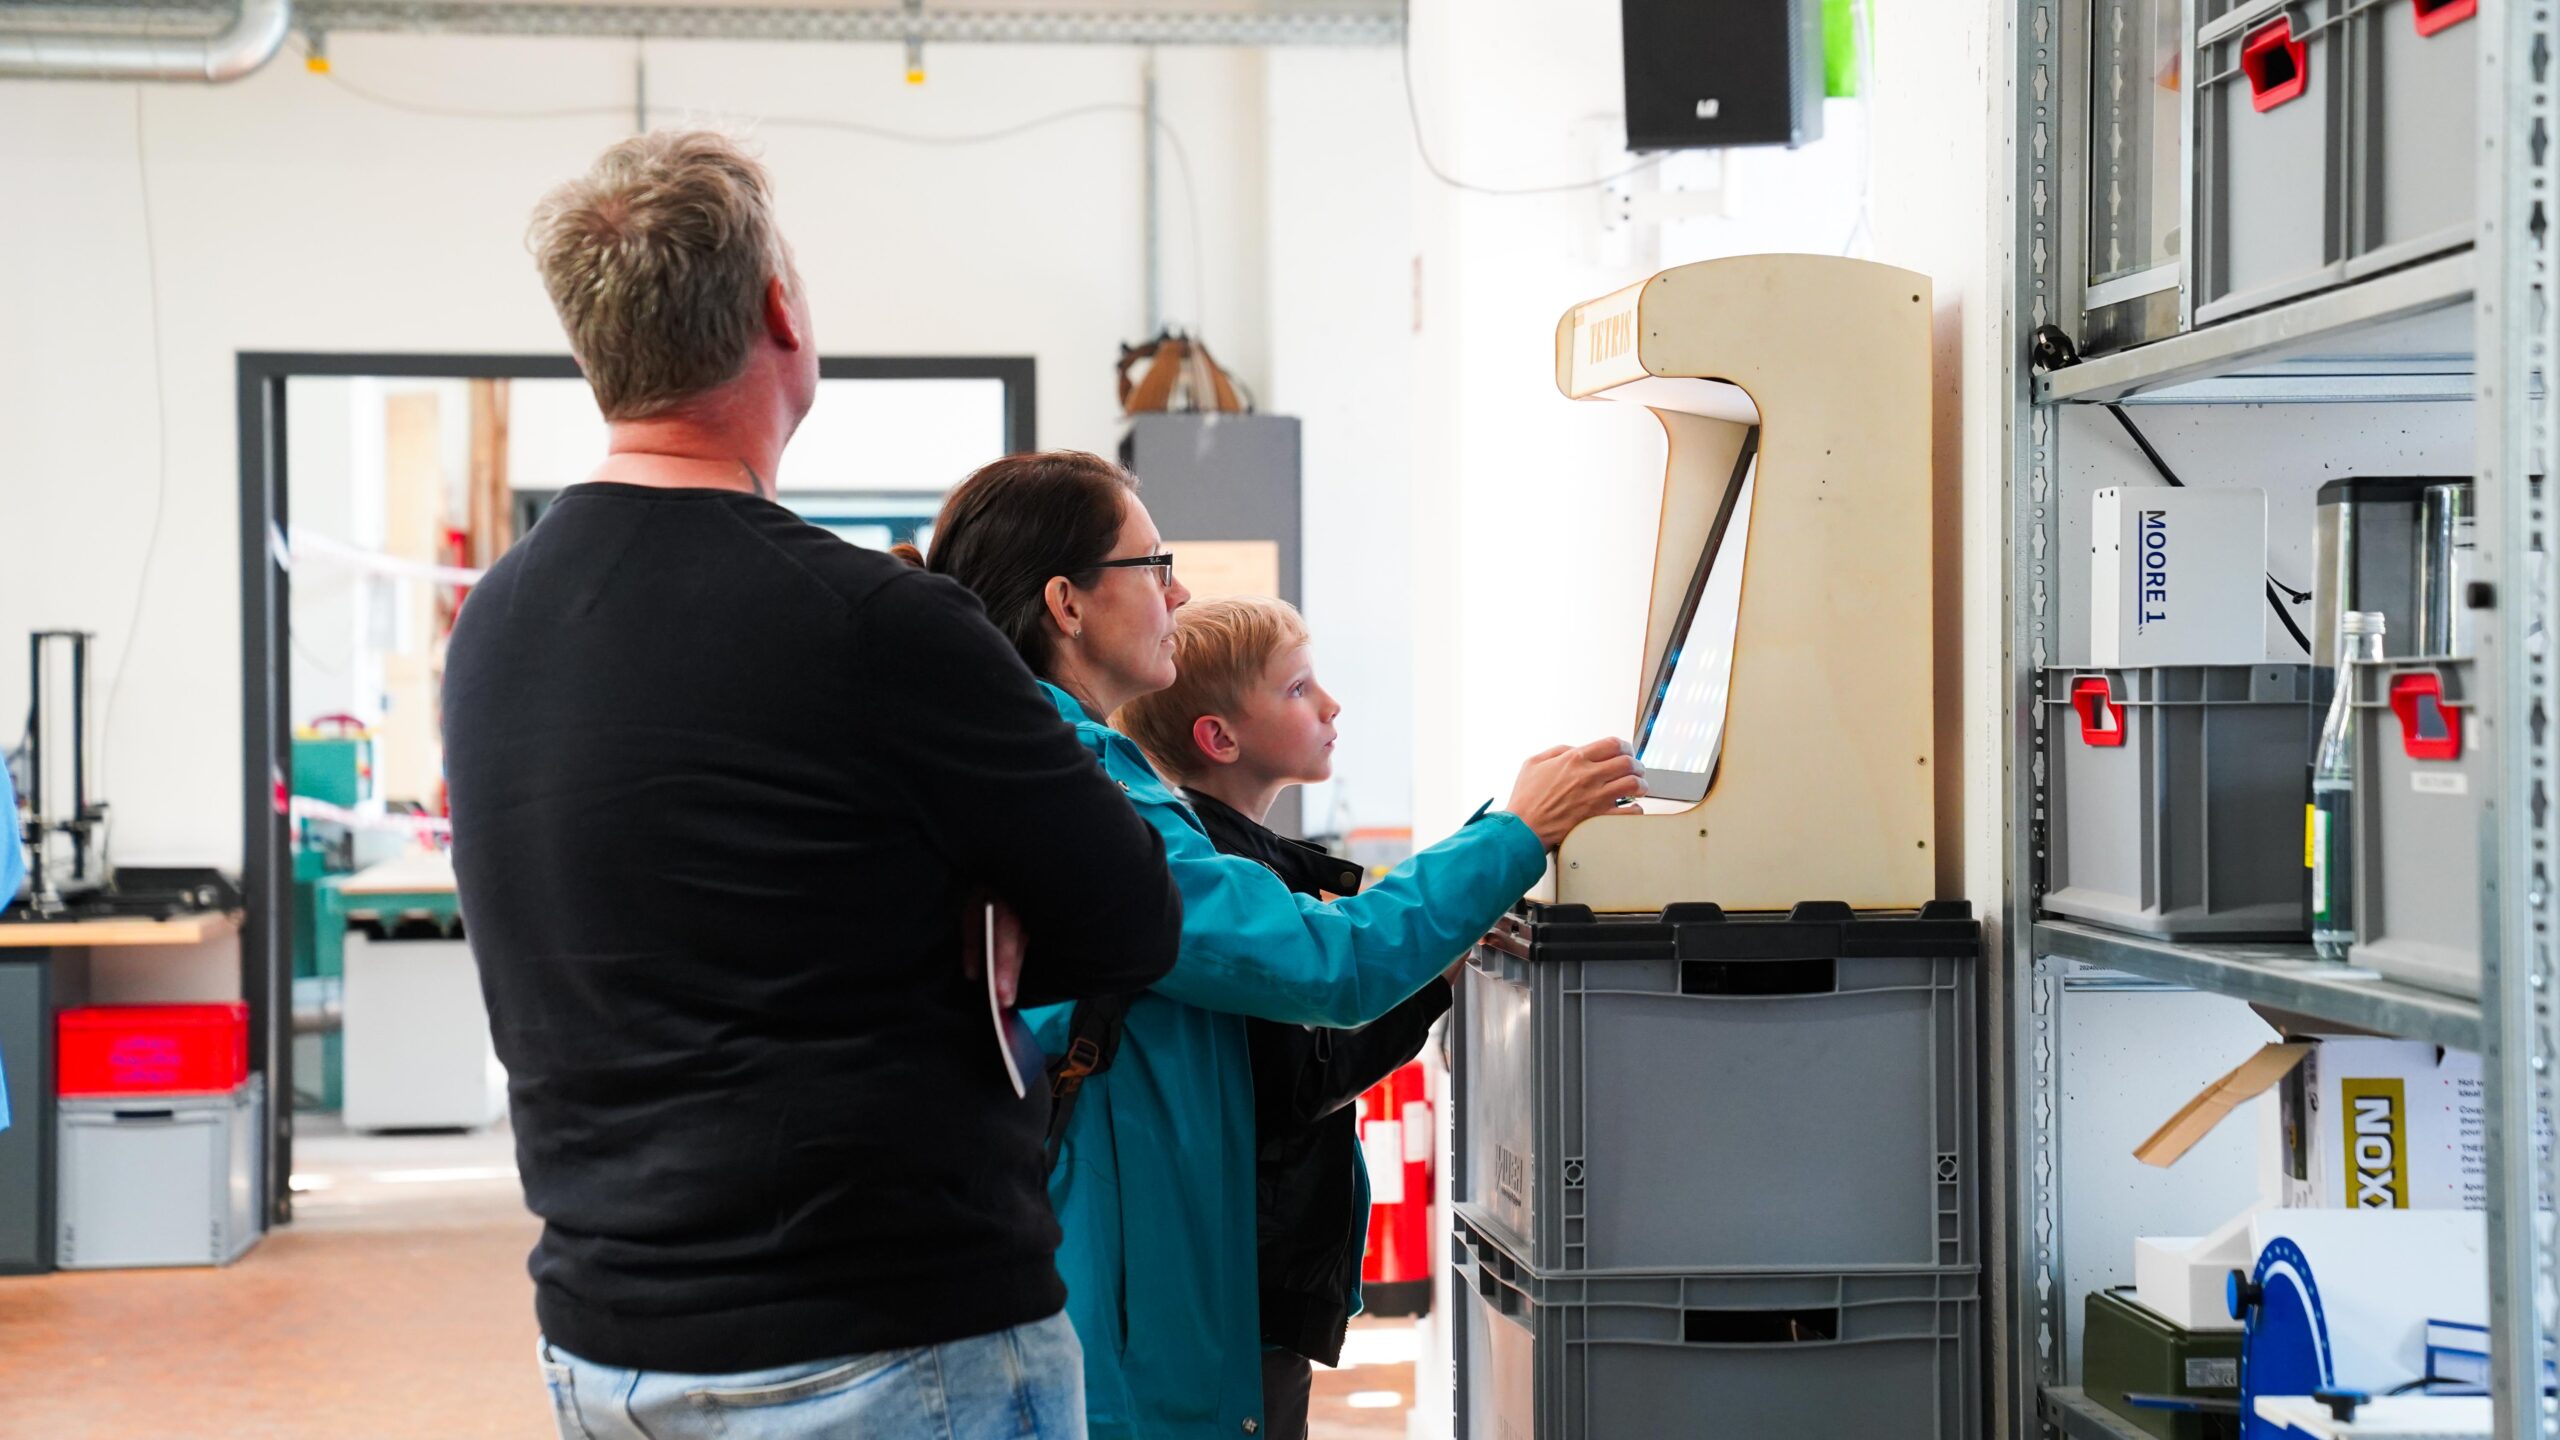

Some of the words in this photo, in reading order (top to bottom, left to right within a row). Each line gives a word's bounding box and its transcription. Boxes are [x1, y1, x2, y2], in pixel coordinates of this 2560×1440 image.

[1590, 310, 1631, 365] TETRIS
[2146, 511, 2166, 602] MOORE
[2146, 611, 2166, 624] 1
